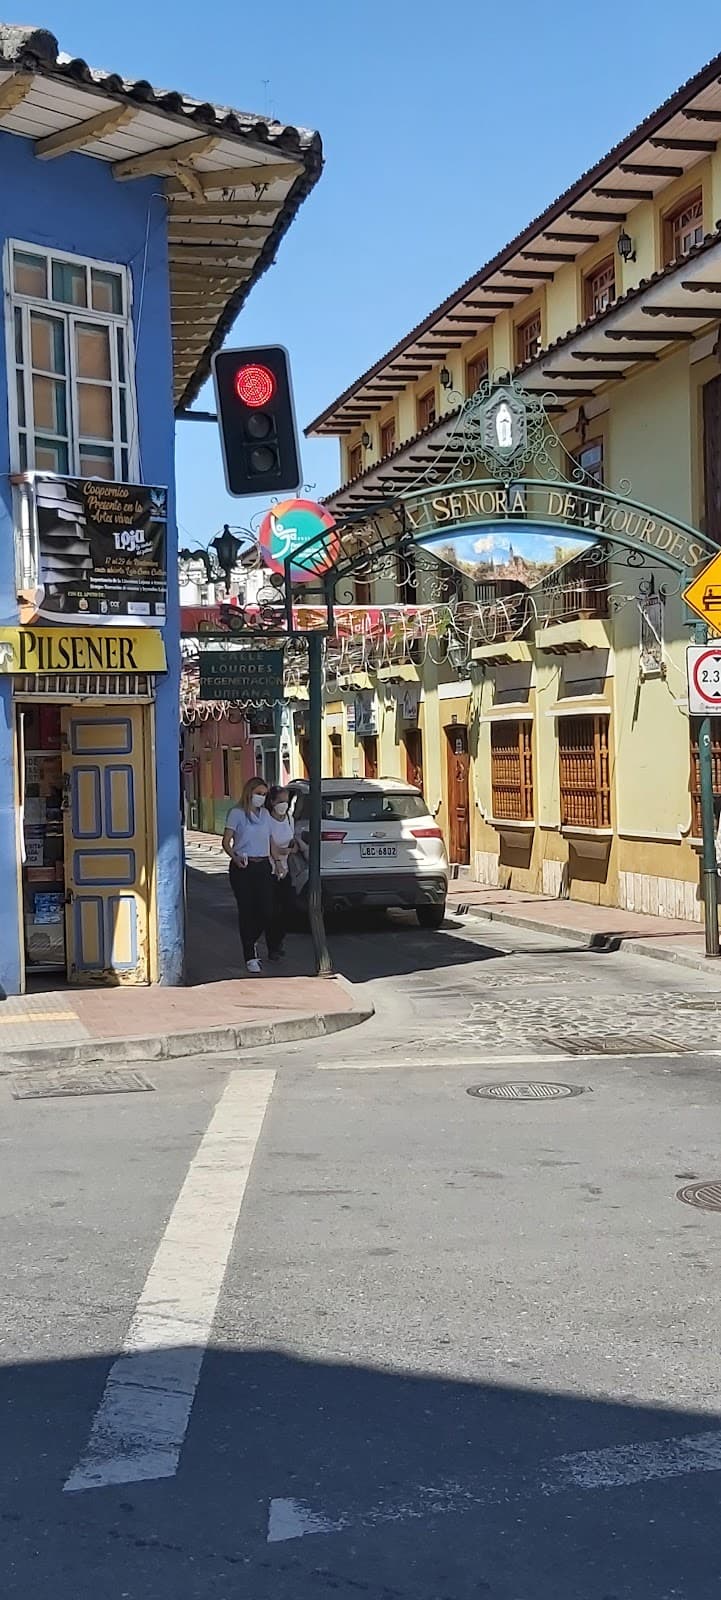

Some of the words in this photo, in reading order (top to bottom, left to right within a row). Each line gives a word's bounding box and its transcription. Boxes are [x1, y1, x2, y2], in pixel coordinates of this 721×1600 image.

[431, 489, 526, 523] SEÑORA
[548, 492, 577, 519] DE
[598, 503, 703, 567] LOURDES
[112, 529, 145, 552] Loja
[18, 631, 138, 670] PILSENER
[211, 664, 273, 674] LOURDES
[213, 689, 270, 698] URBANA
